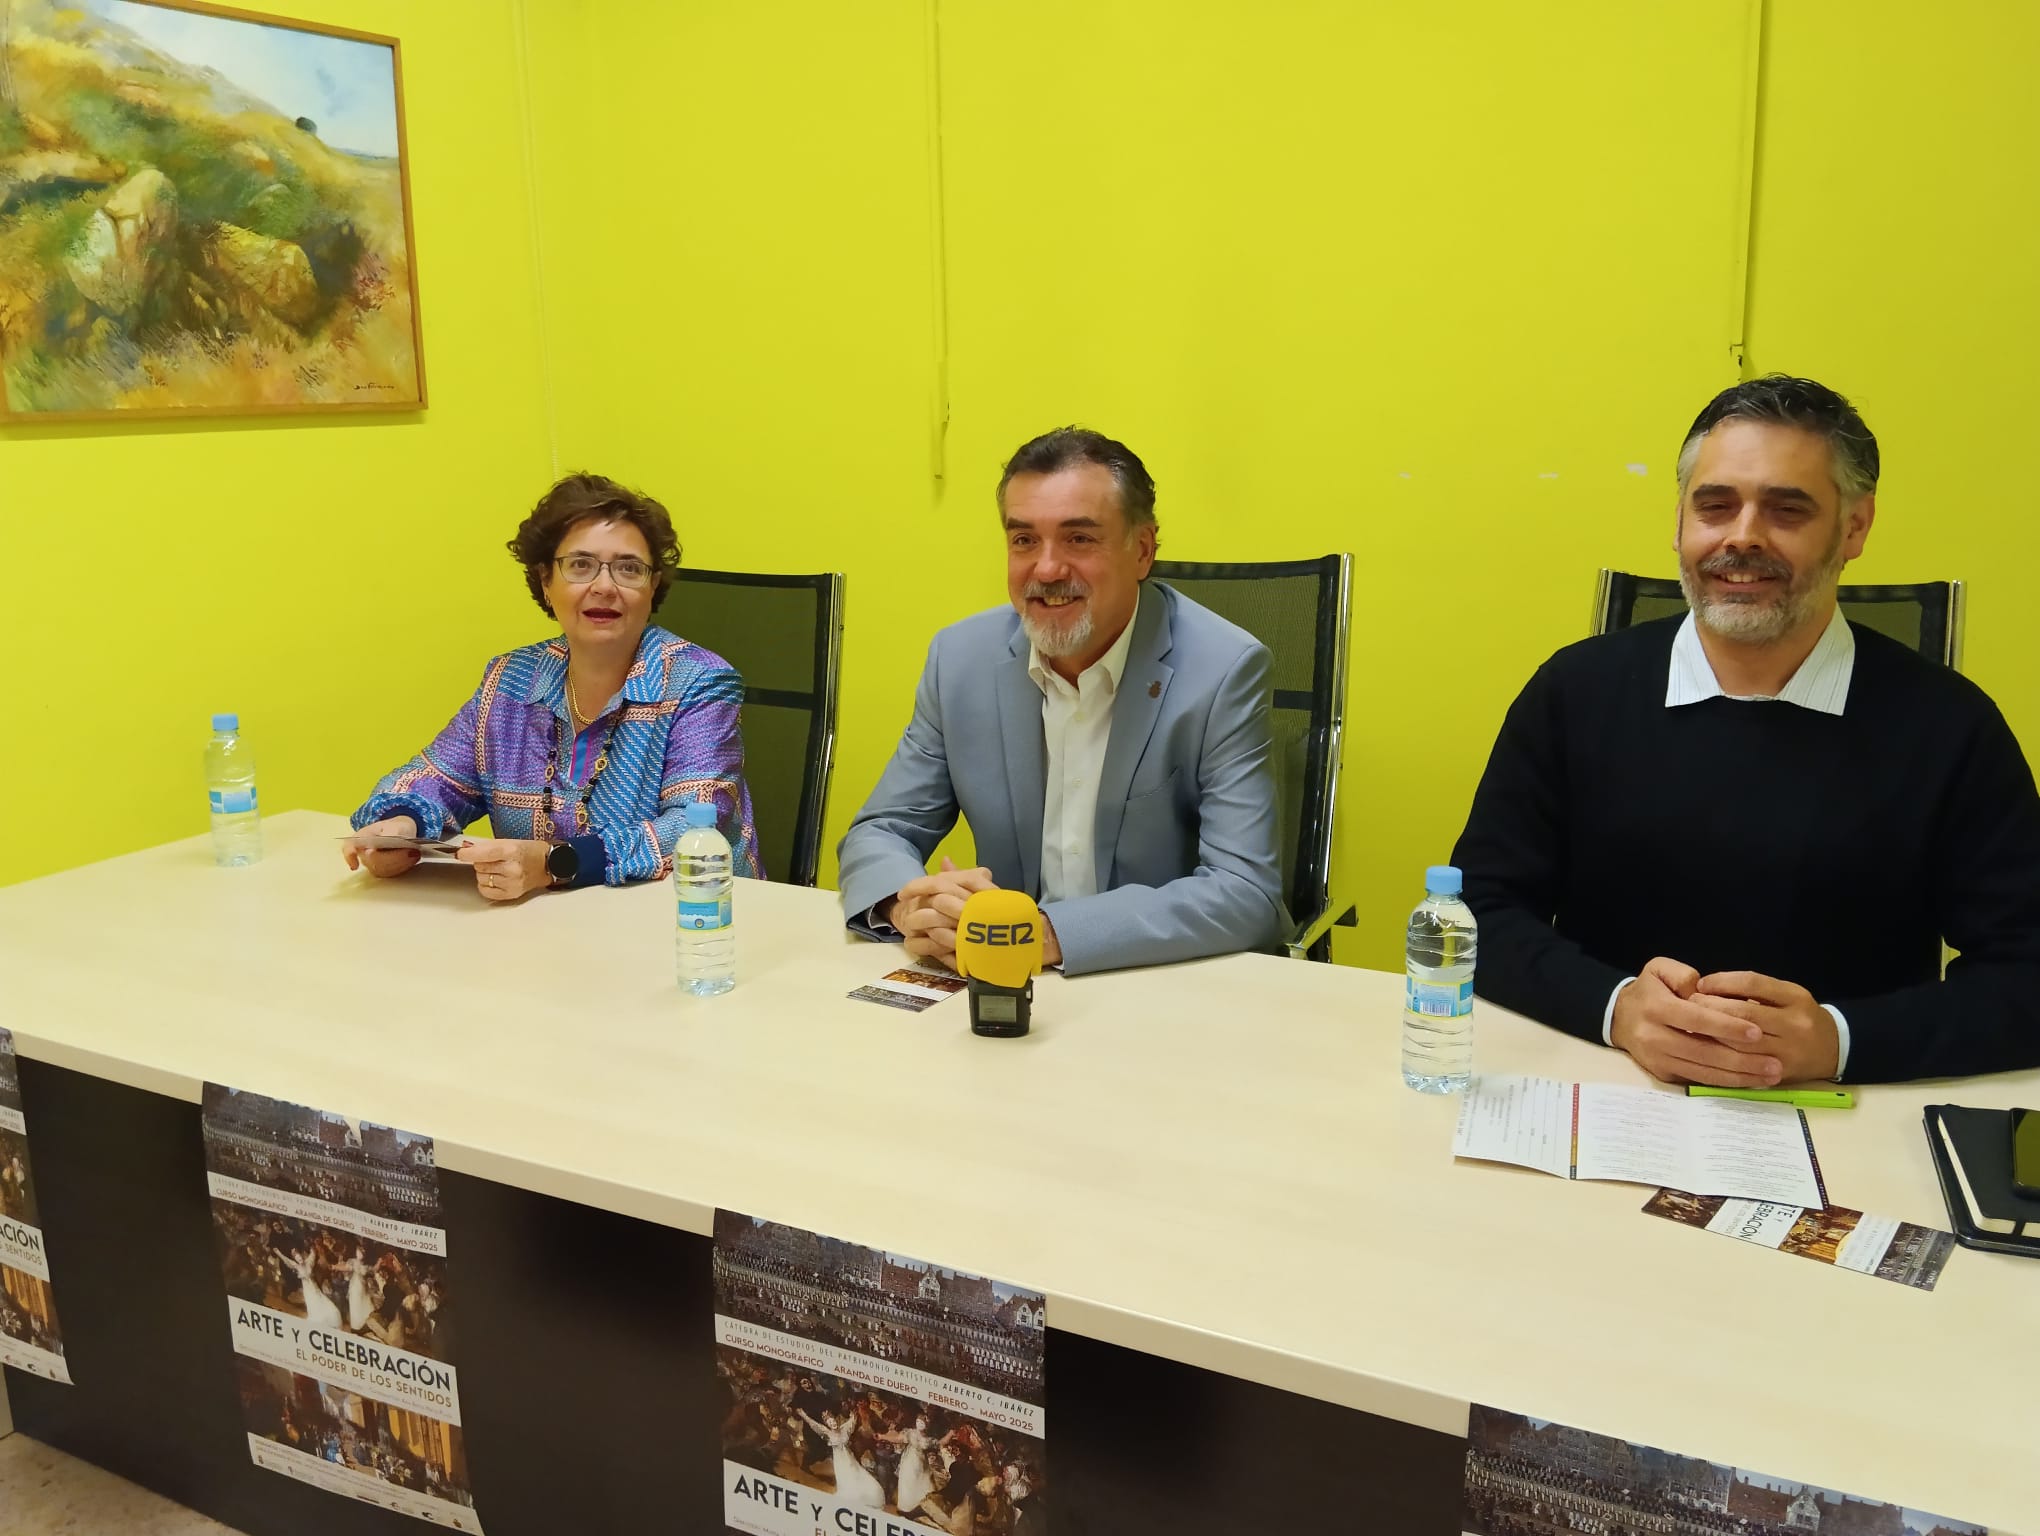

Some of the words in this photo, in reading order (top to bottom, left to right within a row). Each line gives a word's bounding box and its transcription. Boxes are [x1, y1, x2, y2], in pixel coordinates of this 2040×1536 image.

[965, 921, 1035, 946] SER
[396, 1237, 418, 1248] MAYO
[419, 1241, 438, 1252] 2025
[237, 1307, 284, 1339] ARTE
[291, 1327, 300, 1344] Y
[308, 1329, 451, 1392] CELEBRACIÓN
[296, 1348, 308, 1361] EL
[312, 1353, 347, 1375] PODER
[351, 1366, 366, 1380] DE
[369, 1372, 392, 1388] LOS
[396, 1380, 452, 1408] SENTIDOS
[725, 1334, 755, 1348] CURSO
[756, 1343, 824, 1368] MONOGRÁFICO
[834, 1365, 871, 1382] ARANDA
[873, 1375, 885, 1386] DE
[886, 1379, 918, 1395] DUERO
[928, 1391, 969, 1410] FEBRERO
[979, 1408, 1007, 1423] MAYO
[1009, 1416, 1034, 1432] 2025
[942, 1383, 982, 1401] ALBERTO
[733, 1474, 799, 1515] ARTE
[810, 1503, 823, 1522] Y
